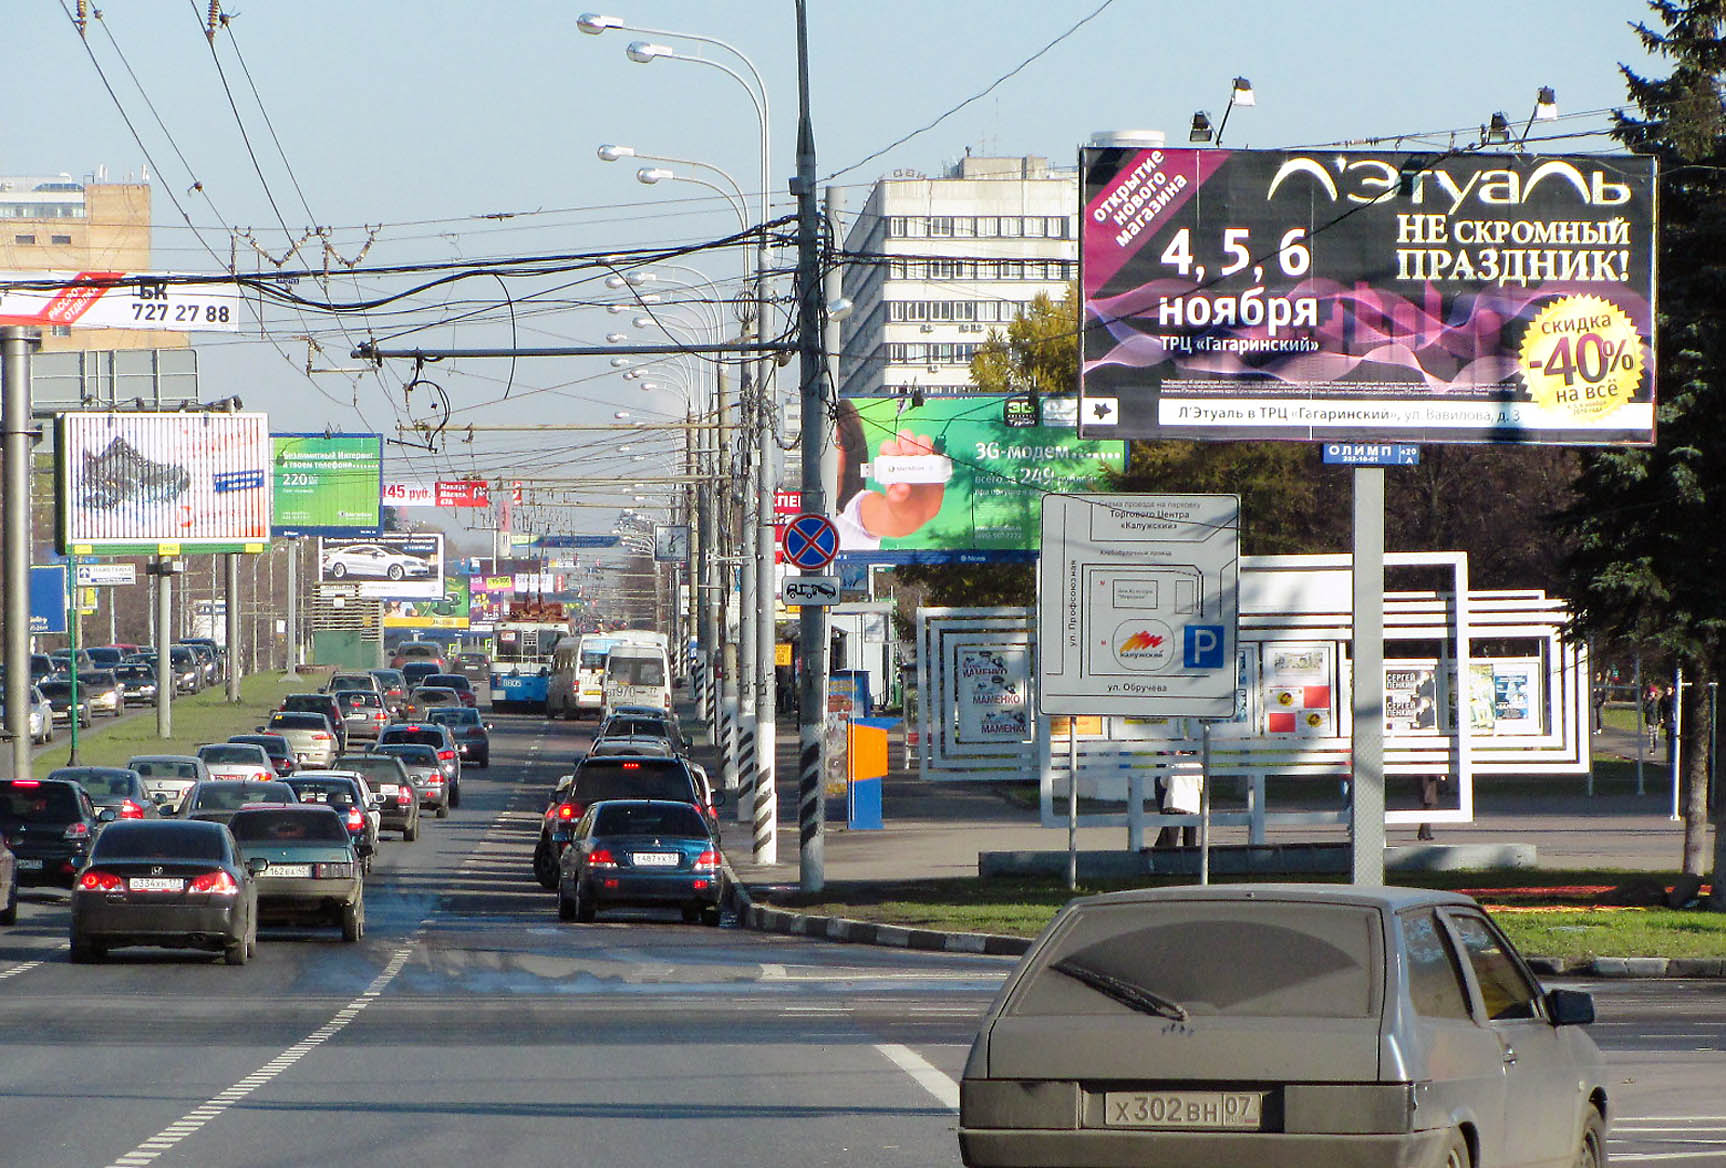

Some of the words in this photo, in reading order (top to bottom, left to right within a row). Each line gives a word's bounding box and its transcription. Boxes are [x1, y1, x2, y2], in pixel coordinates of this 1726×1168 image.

[1093, 150, 1165, 222] открытие
[1113, 171, 1167, 226] нового
[1115, 173, 1188, 248] магазина
[1396, 214, 1449, 244] НЕ
[1454, 217, 1632, 245] СКРОМНЫЙ
[1160, 228, 1206, 283] 4,
[1219, 228, 1265, 283] 5,
[1278, 228, 1312, 277] 6
[1396, 249, 1631, 288] ПРАЗДНИК!
[131, 303, 169, 321] 727
[175, 305, 200, 322] 27
[205, 306, 230, 323] 88
[1158, 286, 1319, 337] ноября
[1541, 314, 1612, 335] скидка
[1160, 336, 1193, 354] ТРЦ
[1196, 336, 1320, 354] «Гагаринский»
[1529, 332, 1634, 386] -40%
[1555, 387, 1579, 404] на
[1584, 378, 1619, 400] всё
[1178, 406, 1244, 422] Л'Этуаль
[1248, 409, 1256, 419] в
[1260, 407, 1289, 422] ТРЦ
[1496, 411, 1510, 424] д.
[1513, 409, 1520, 422] 3
[1329, 445, 1392, 456] ОЛИМП
[283, 473, 308, 486] 220
[1020, 467, 1055, 485] 249
[1157, 509, 1190, 519] Центра
[1107, 683, 1121, 692] ул.
[1123, 682, 1168, 693] Обручева
[1115, 1097, 1218, 1122] Х302ВН
[1225, 1097, 1250, 1116] 07
